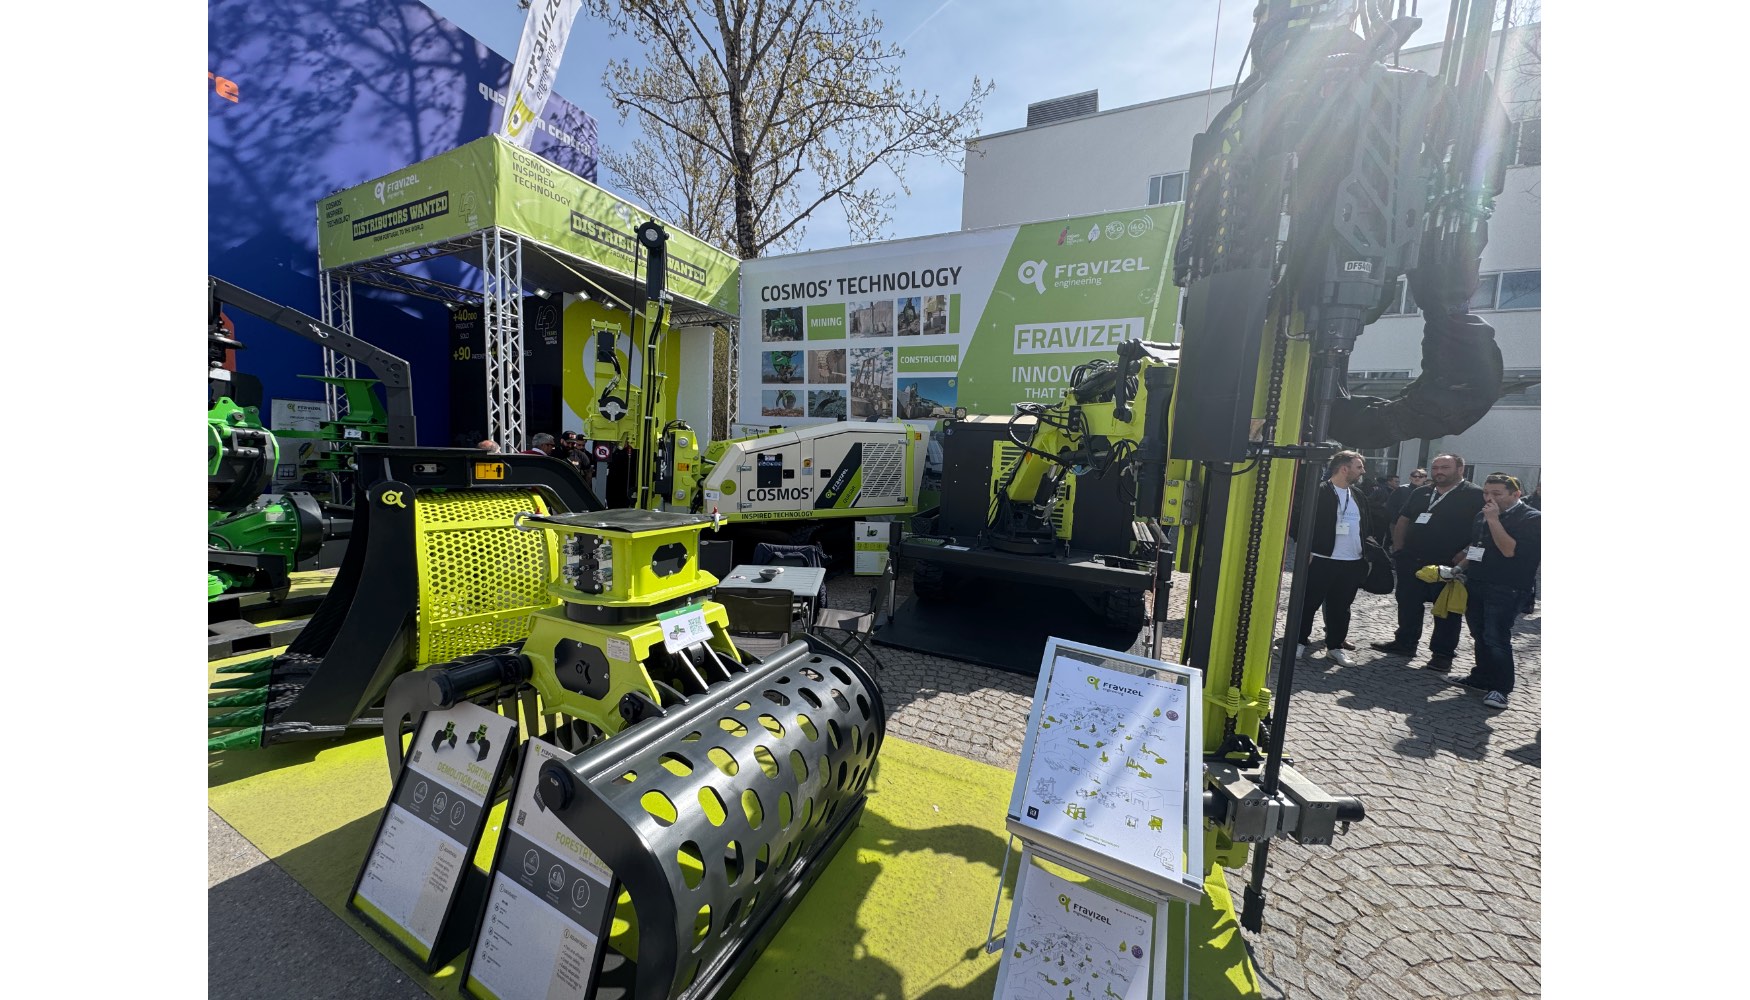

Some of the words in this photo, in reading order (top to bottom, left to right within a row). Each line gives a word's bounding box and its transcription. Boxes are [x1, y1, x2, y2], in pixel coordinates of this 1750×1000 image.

[536, 38, 557, 100] engineering
[512, 162, 555, 189] INSPIRED
[512, 174, 571, 207] TECHNOLOGY
[353, 209, 408, 238] DISTRIBUTORS
[409, 195, 448, 220] WANTED
[836, 266, 962, 296] TECHNOLOGY
[1054, 277, 1102, 289] engineering
[811, 317, 842, 328] MINING
[453, 346, 470, 360] +90
[900, 354, 957, 364] CONSTRUCTION
[1025, 388, 1056, 399] THAT
[741, 511, 772, 520] INSPIRED
[774, 510, 814, 519] TECHNOLOGY
[437, 762, 472, 785] DEMOLITION
[555, 831, 592, 860] FORESTRY
